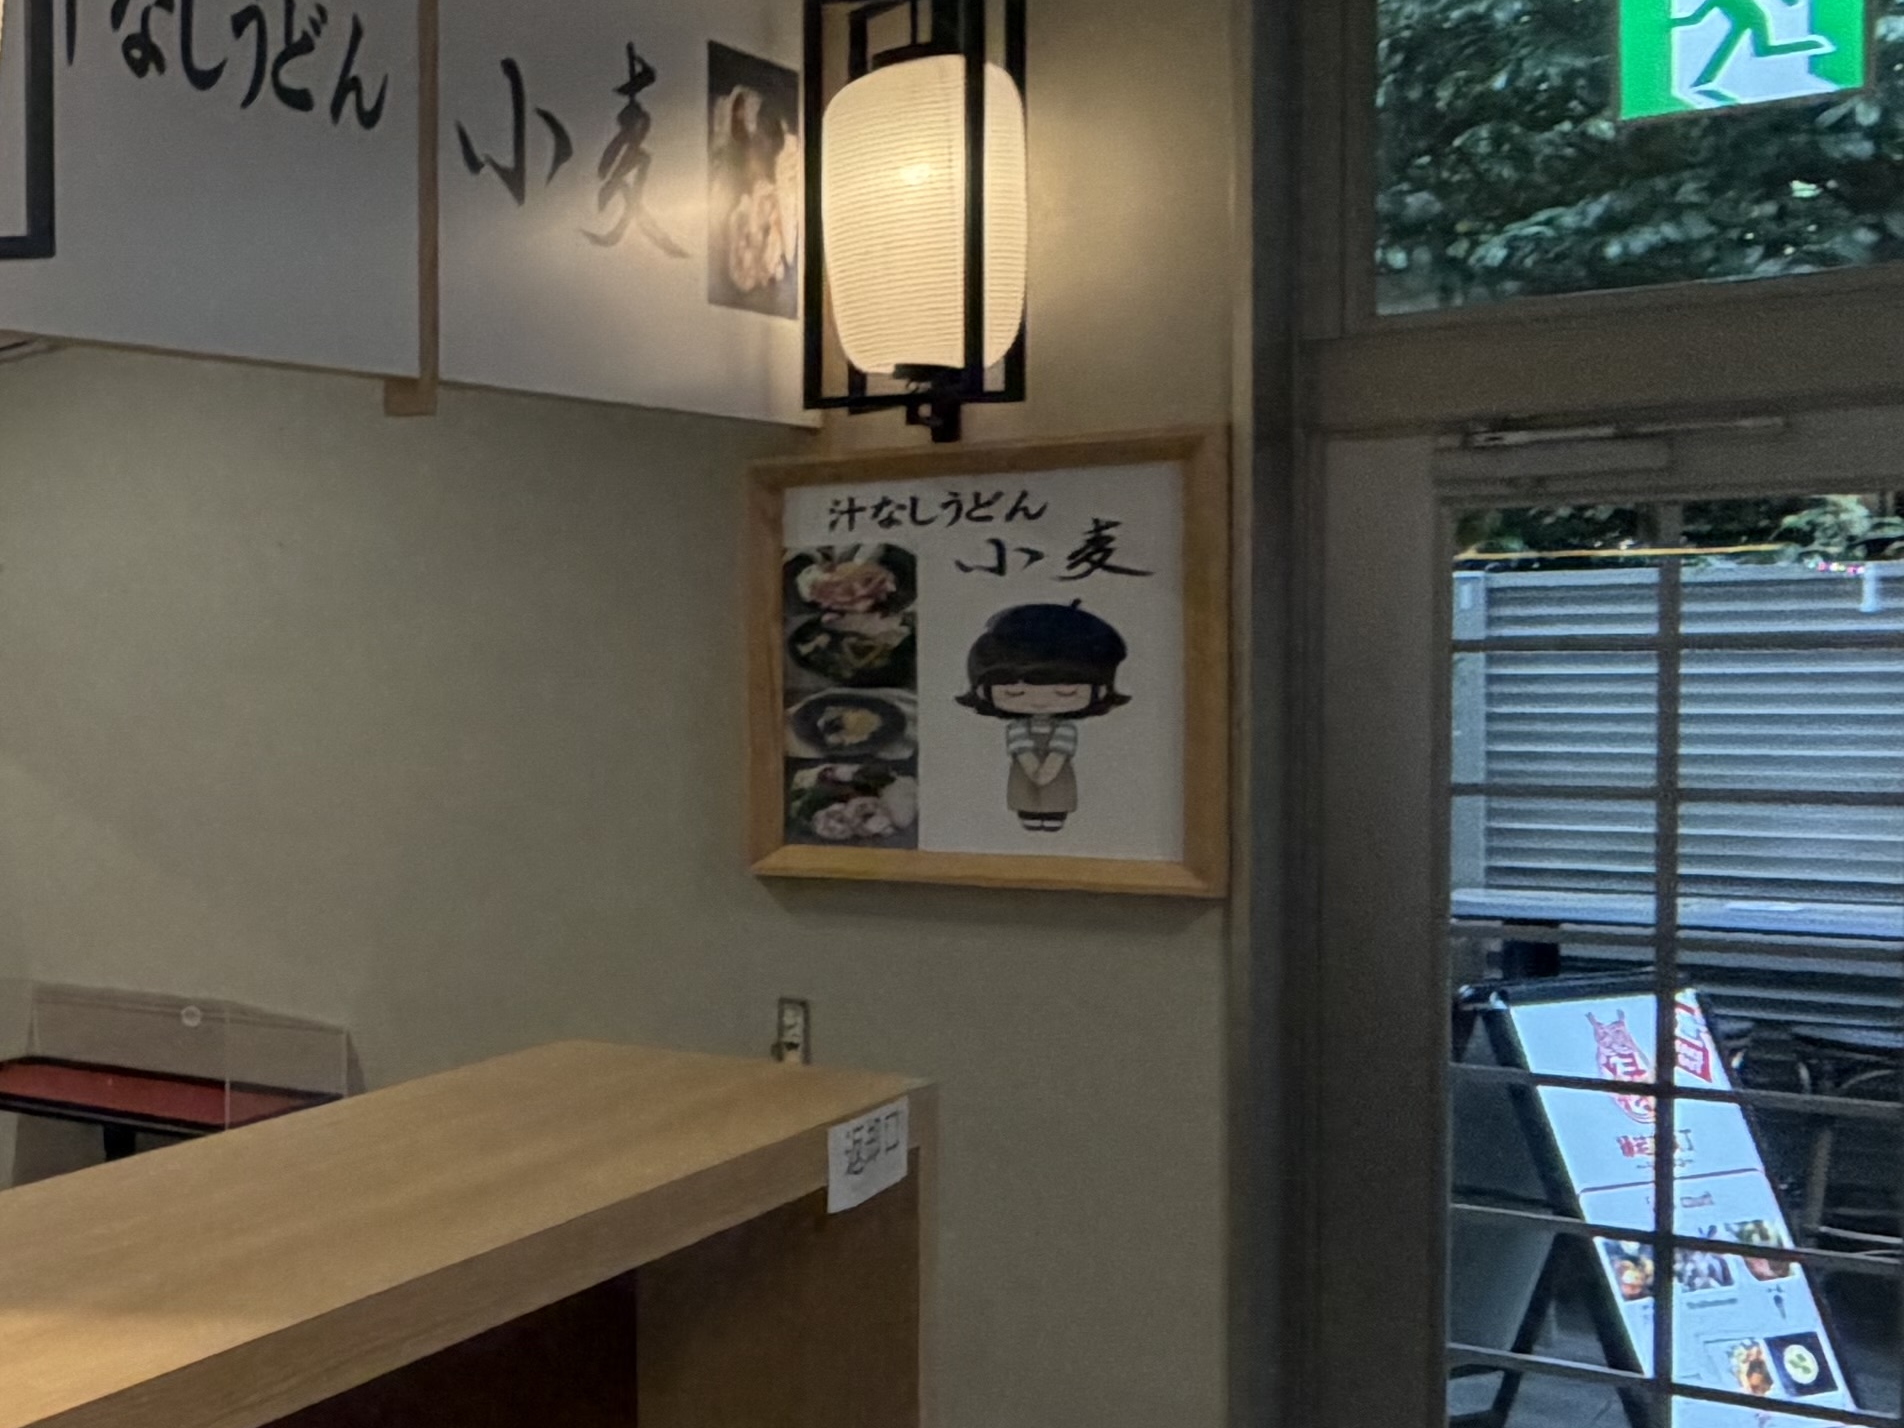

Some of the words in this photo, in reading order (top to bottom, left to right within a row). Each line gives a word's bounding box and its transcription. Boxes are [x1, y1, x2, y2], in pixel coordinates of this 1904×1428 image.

[455, 41, 690, 259] 小麦
[827, 489, 1048, 533] 汁なしうどん
[954, 517, 1156, 582] 小麦
